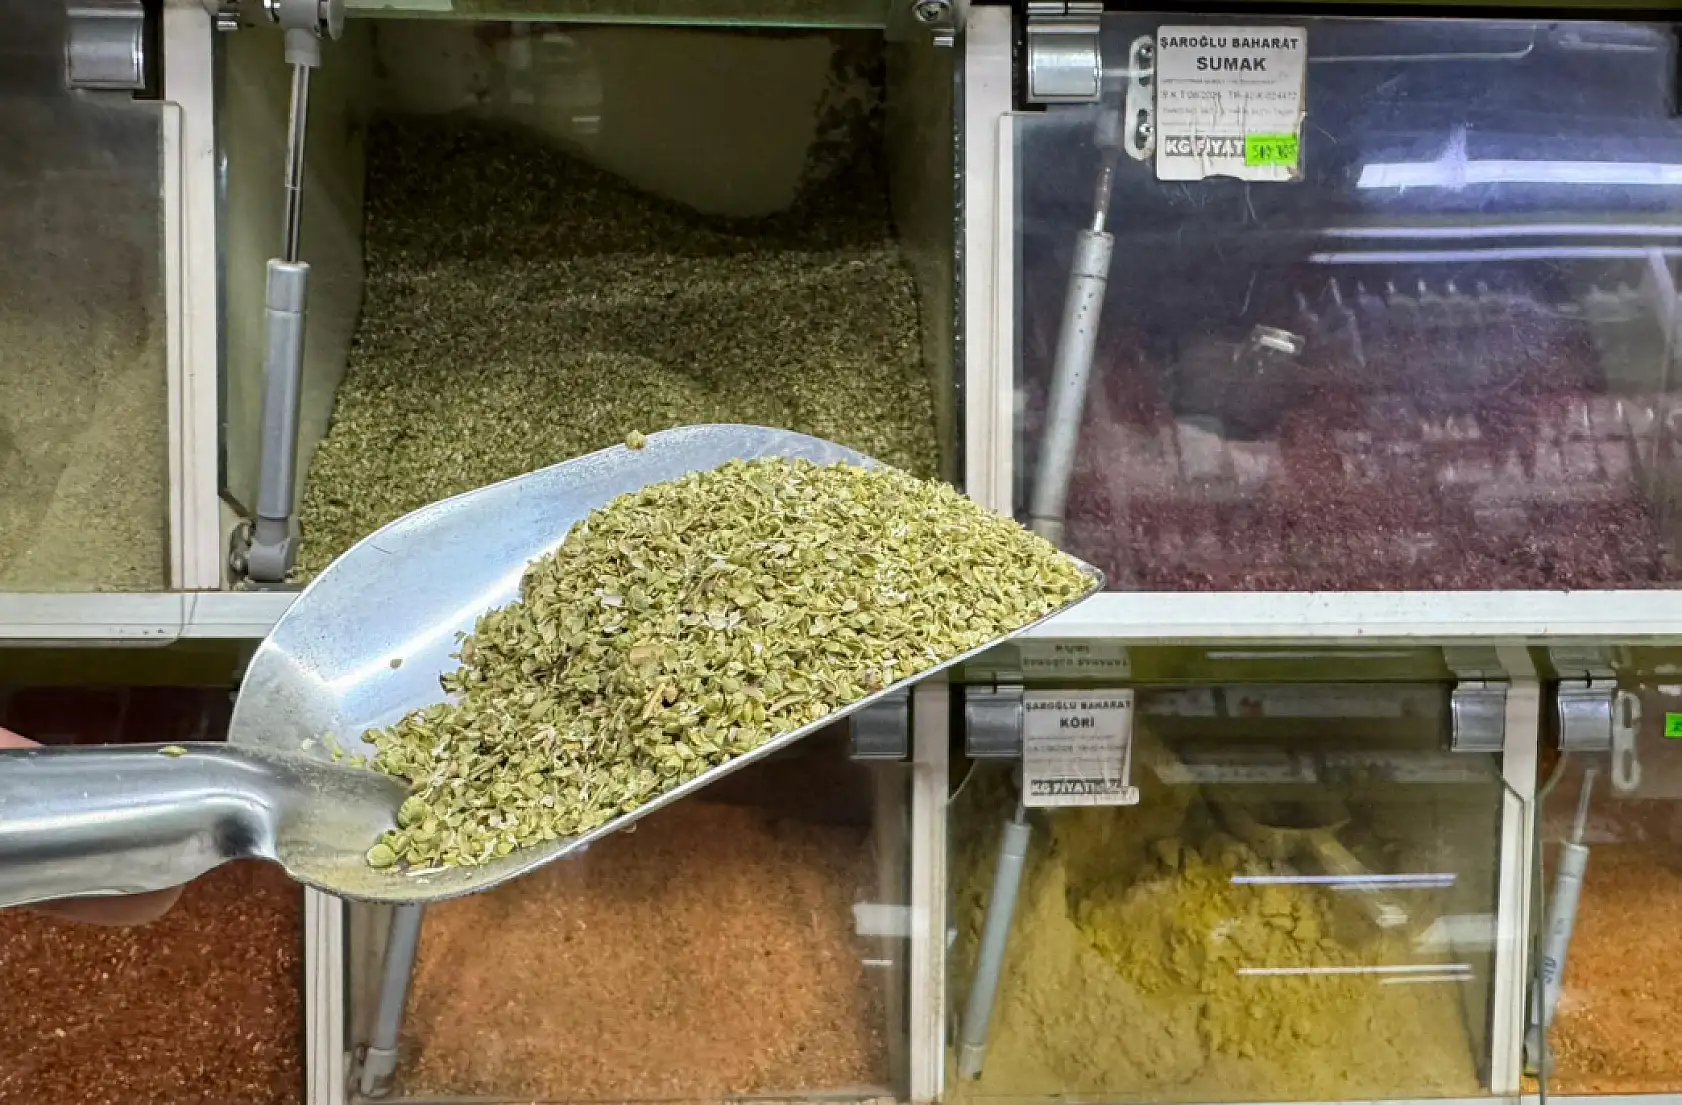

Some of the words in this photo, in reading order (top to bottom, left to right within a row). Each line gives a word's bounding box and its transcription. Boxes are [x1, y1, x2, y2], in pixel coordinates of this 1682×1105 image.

[1160, 35, 1227, 49] ŞAROĞLU
[1232, 37, 1299, 50] BAHARAT
[1196, 56, 1266, 71] SUMAK
[1165, 138, 1190, 154] KG
[1081, 700, 1130, 710] BAHARAT
[1031, 780, 1051, 795] KG
